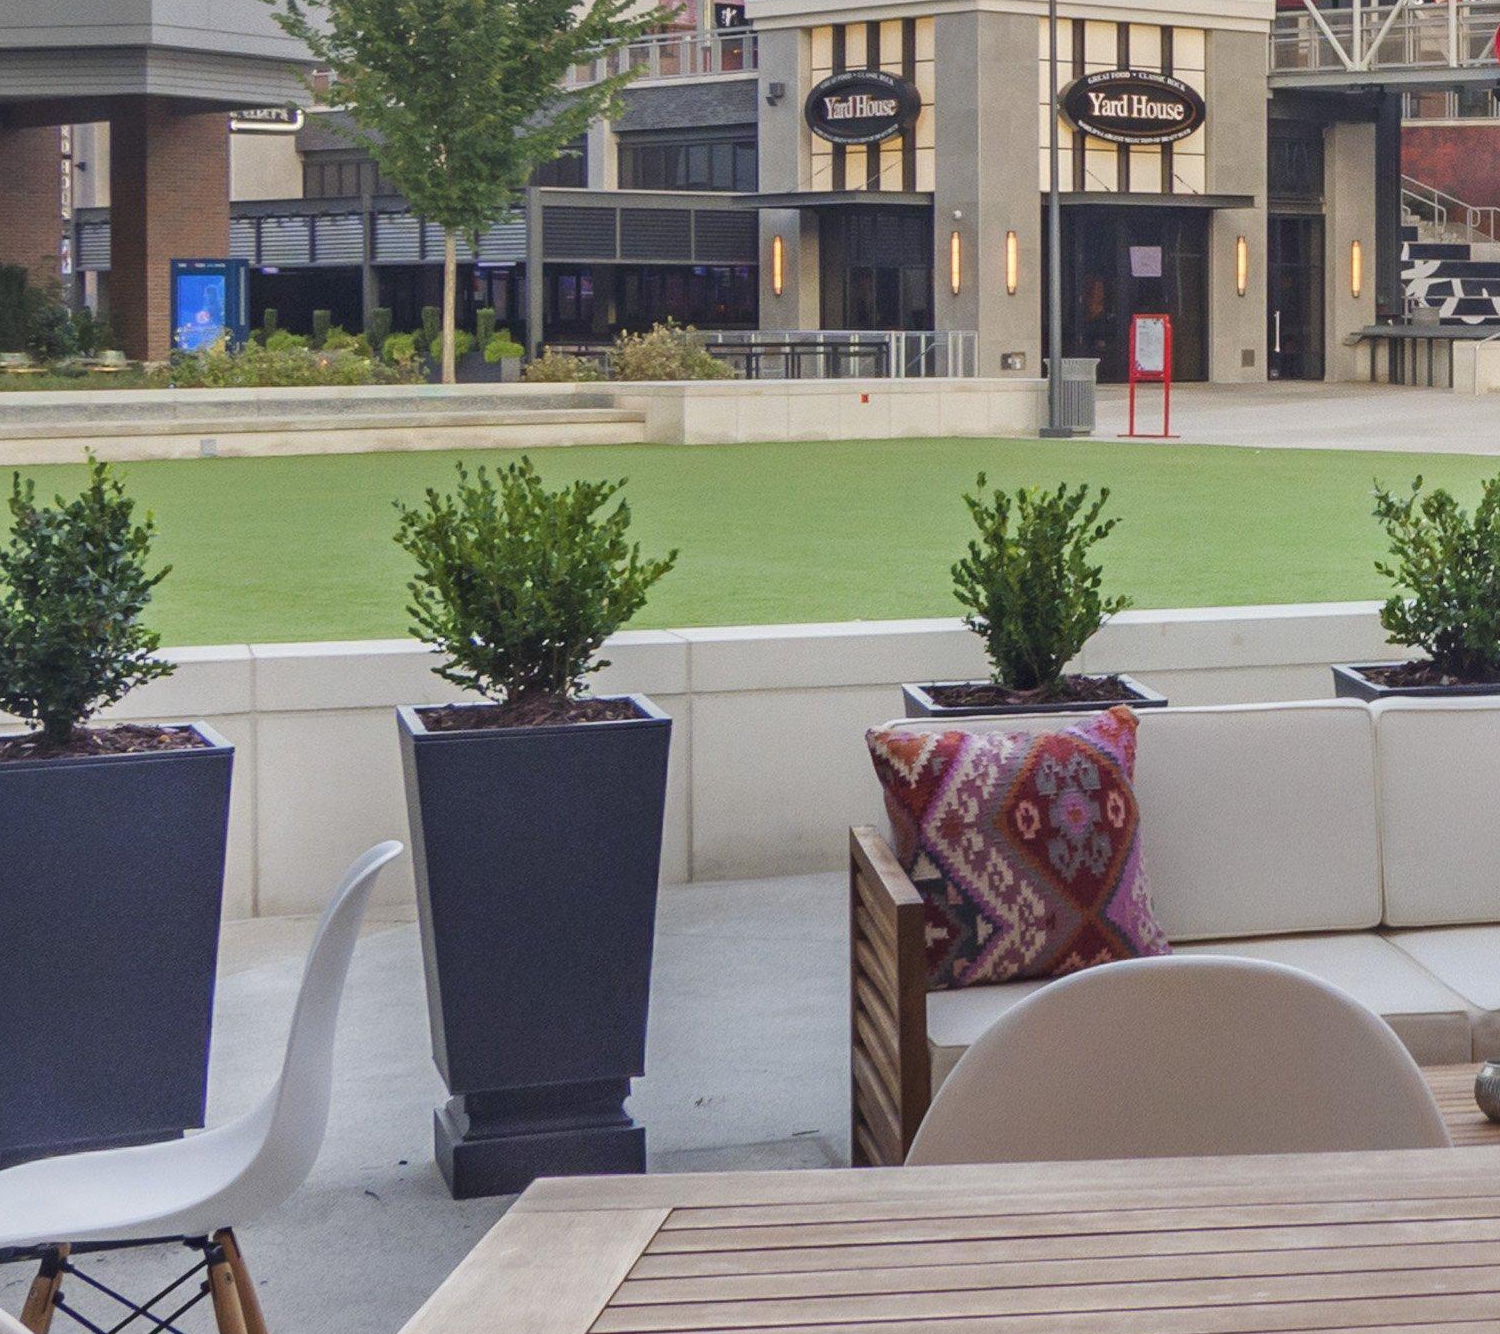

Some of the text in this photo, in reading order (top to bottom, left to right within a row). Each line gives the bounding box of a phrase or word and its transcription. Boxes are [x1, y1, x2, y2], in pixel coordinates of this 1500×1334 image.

[823, 94, 897, 120] Yard House
[1088, 92, 1185, 121] Yard House
